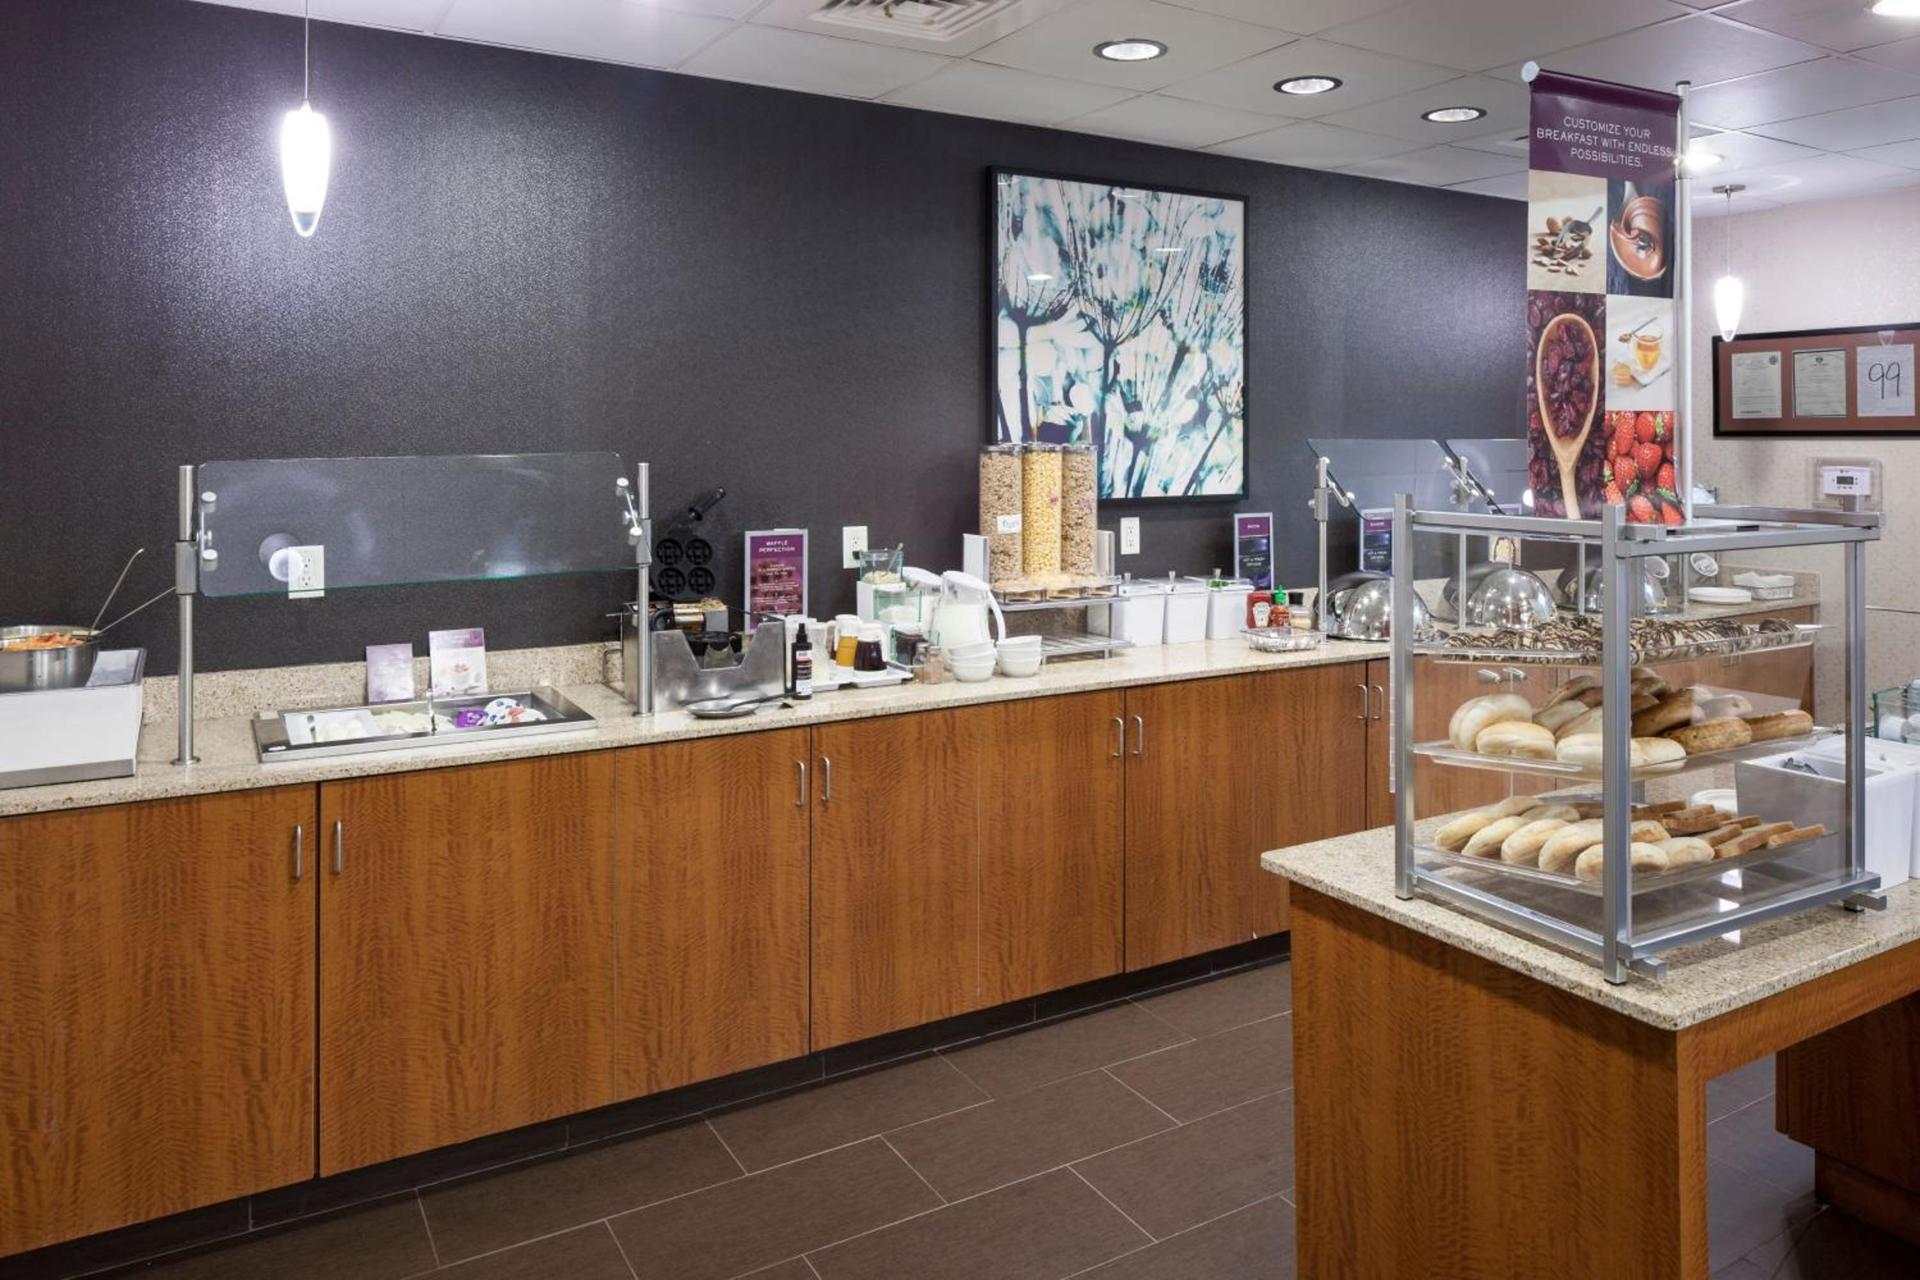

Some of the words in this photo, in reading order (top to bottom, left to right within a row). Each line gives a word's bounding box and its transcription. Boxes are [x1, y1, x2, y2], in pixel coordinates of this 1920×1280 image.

[1563, 116, 1621, 136] CUSTOMIZE
[1623, 125, 1652, 139] YOUR
[1536, 128, 1599, 147] BREAKFAST
[1600, 137, 1626, 150] WITH
[1628, 141, 1672, 157] ENDLESS
[1570, 147, 1643, 168] POSSIBILITIES.
[1868, 361, 1901, 400] 99
